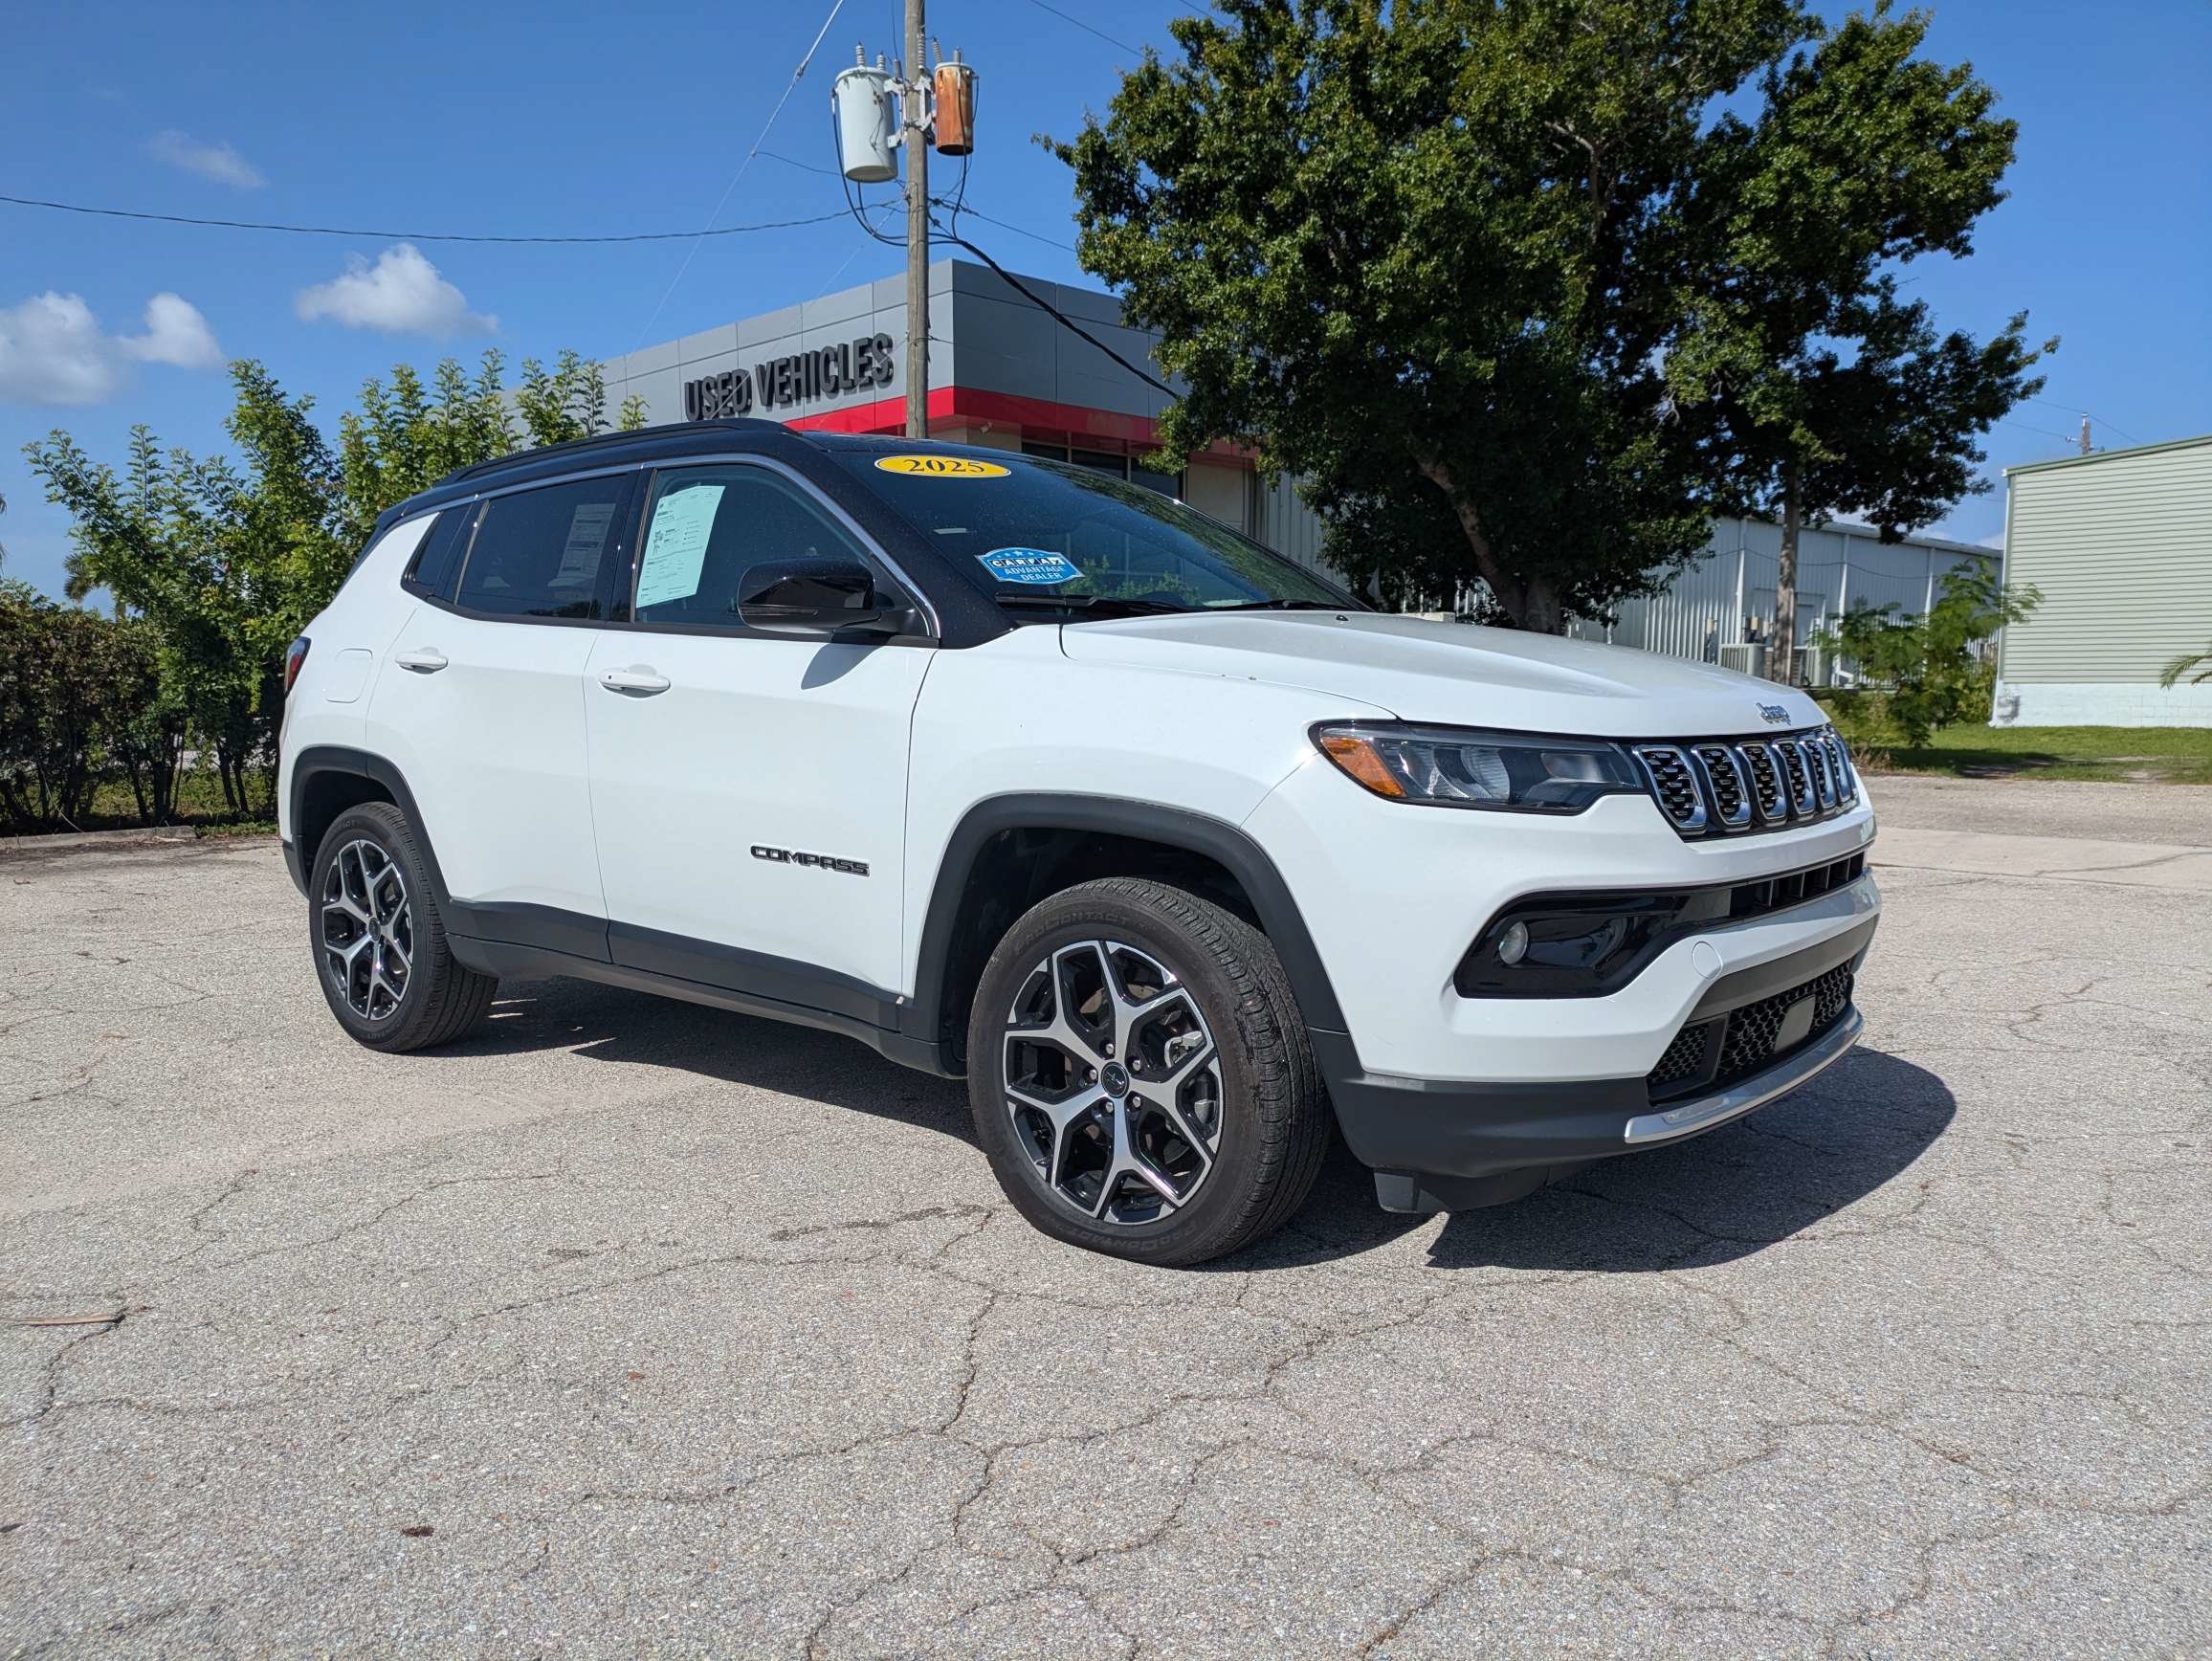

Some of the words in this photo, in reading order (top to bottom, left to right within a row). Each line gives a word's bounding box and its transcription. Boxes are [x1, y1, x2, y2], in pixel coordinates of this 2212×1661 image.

[685, 368, 753, 421] USED
[755, 332, 895, 409] VEHICLES
[903, 458, 984, 473] 2025
[989, 557, 1067, 568] CARFAX
[1004, 565, 1065, 576] ADVANTAGE
[1755, 702, 1791, 726] Jeep
[750, 845, 870, 877] COMPASS
